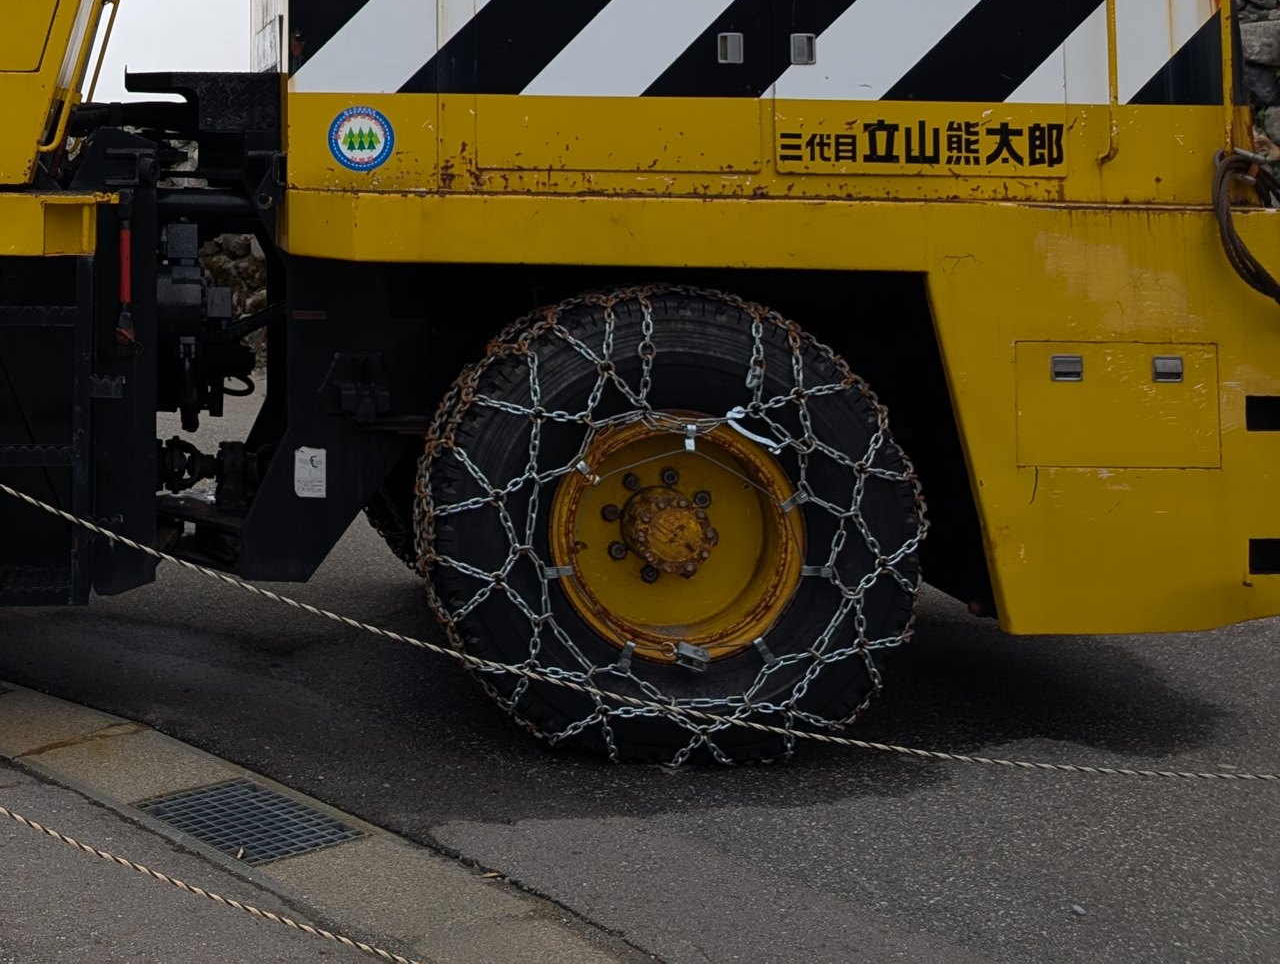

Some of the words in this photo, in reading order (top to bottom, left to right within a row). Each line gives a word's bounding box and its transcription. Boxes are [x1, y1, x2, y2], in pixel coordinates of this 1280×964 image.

[779, 119, 1065, 167] 三代目立山熊太郎
